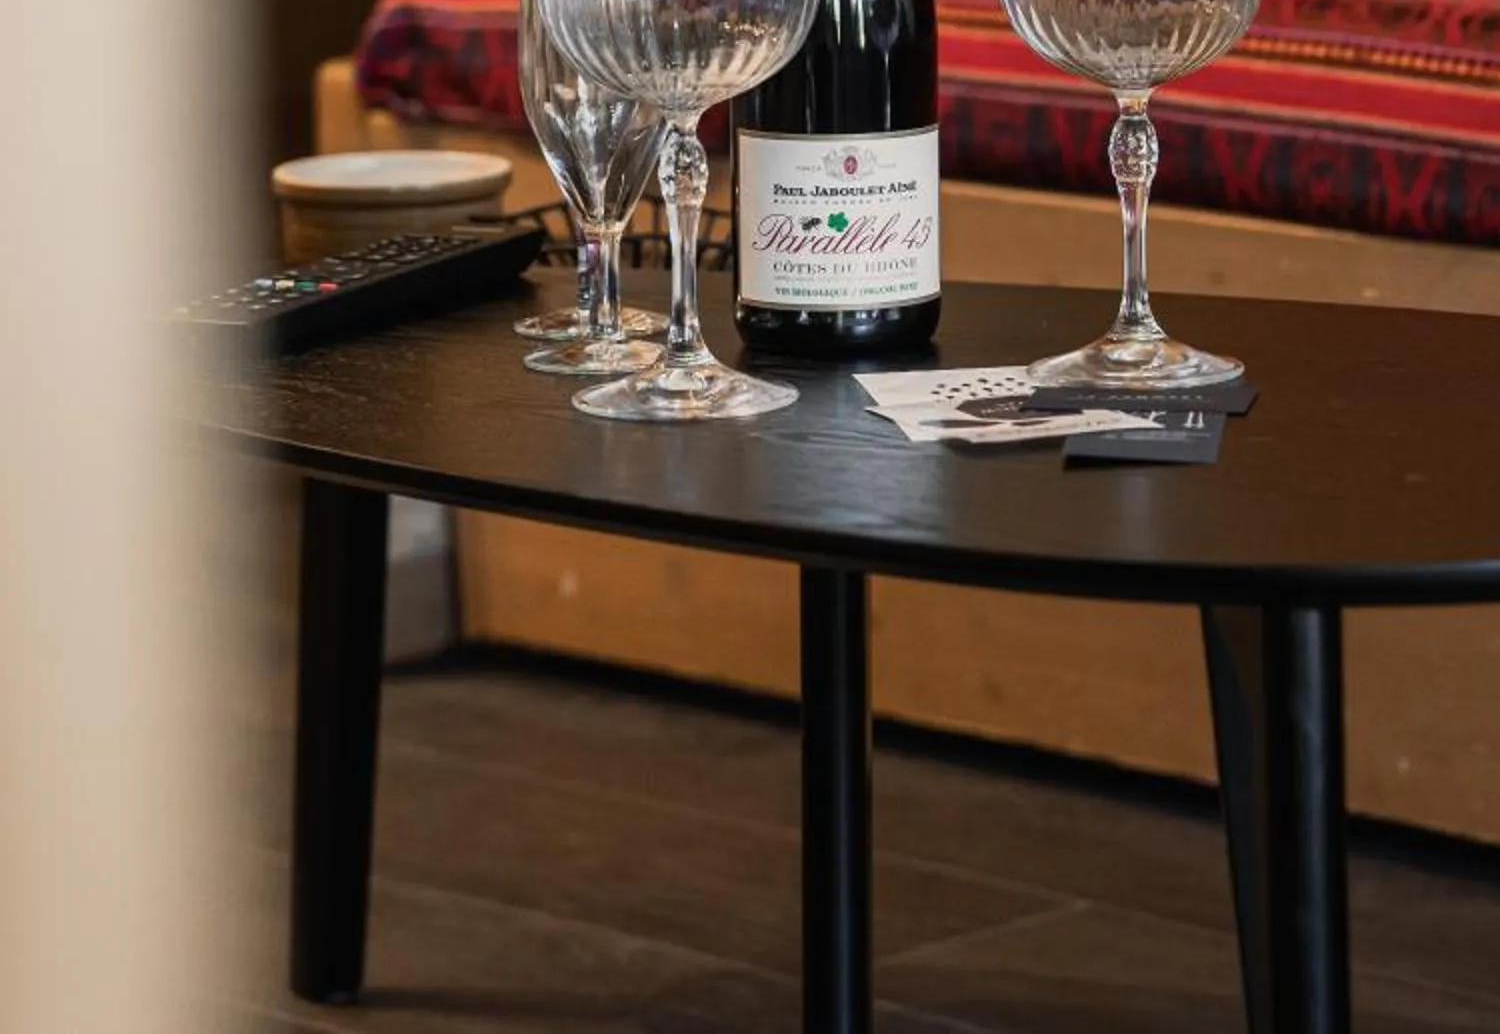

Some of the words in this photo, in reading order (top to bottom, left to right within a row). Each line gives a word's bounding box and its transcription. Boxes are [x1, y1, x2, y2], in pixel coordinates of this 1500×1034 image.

[773, 183, 807, 197] PAUL
[810, 184, 886, 197] JABOULET
[900, 217, 932, 249] 43
[773, 259, 827, 274] CÔTES
